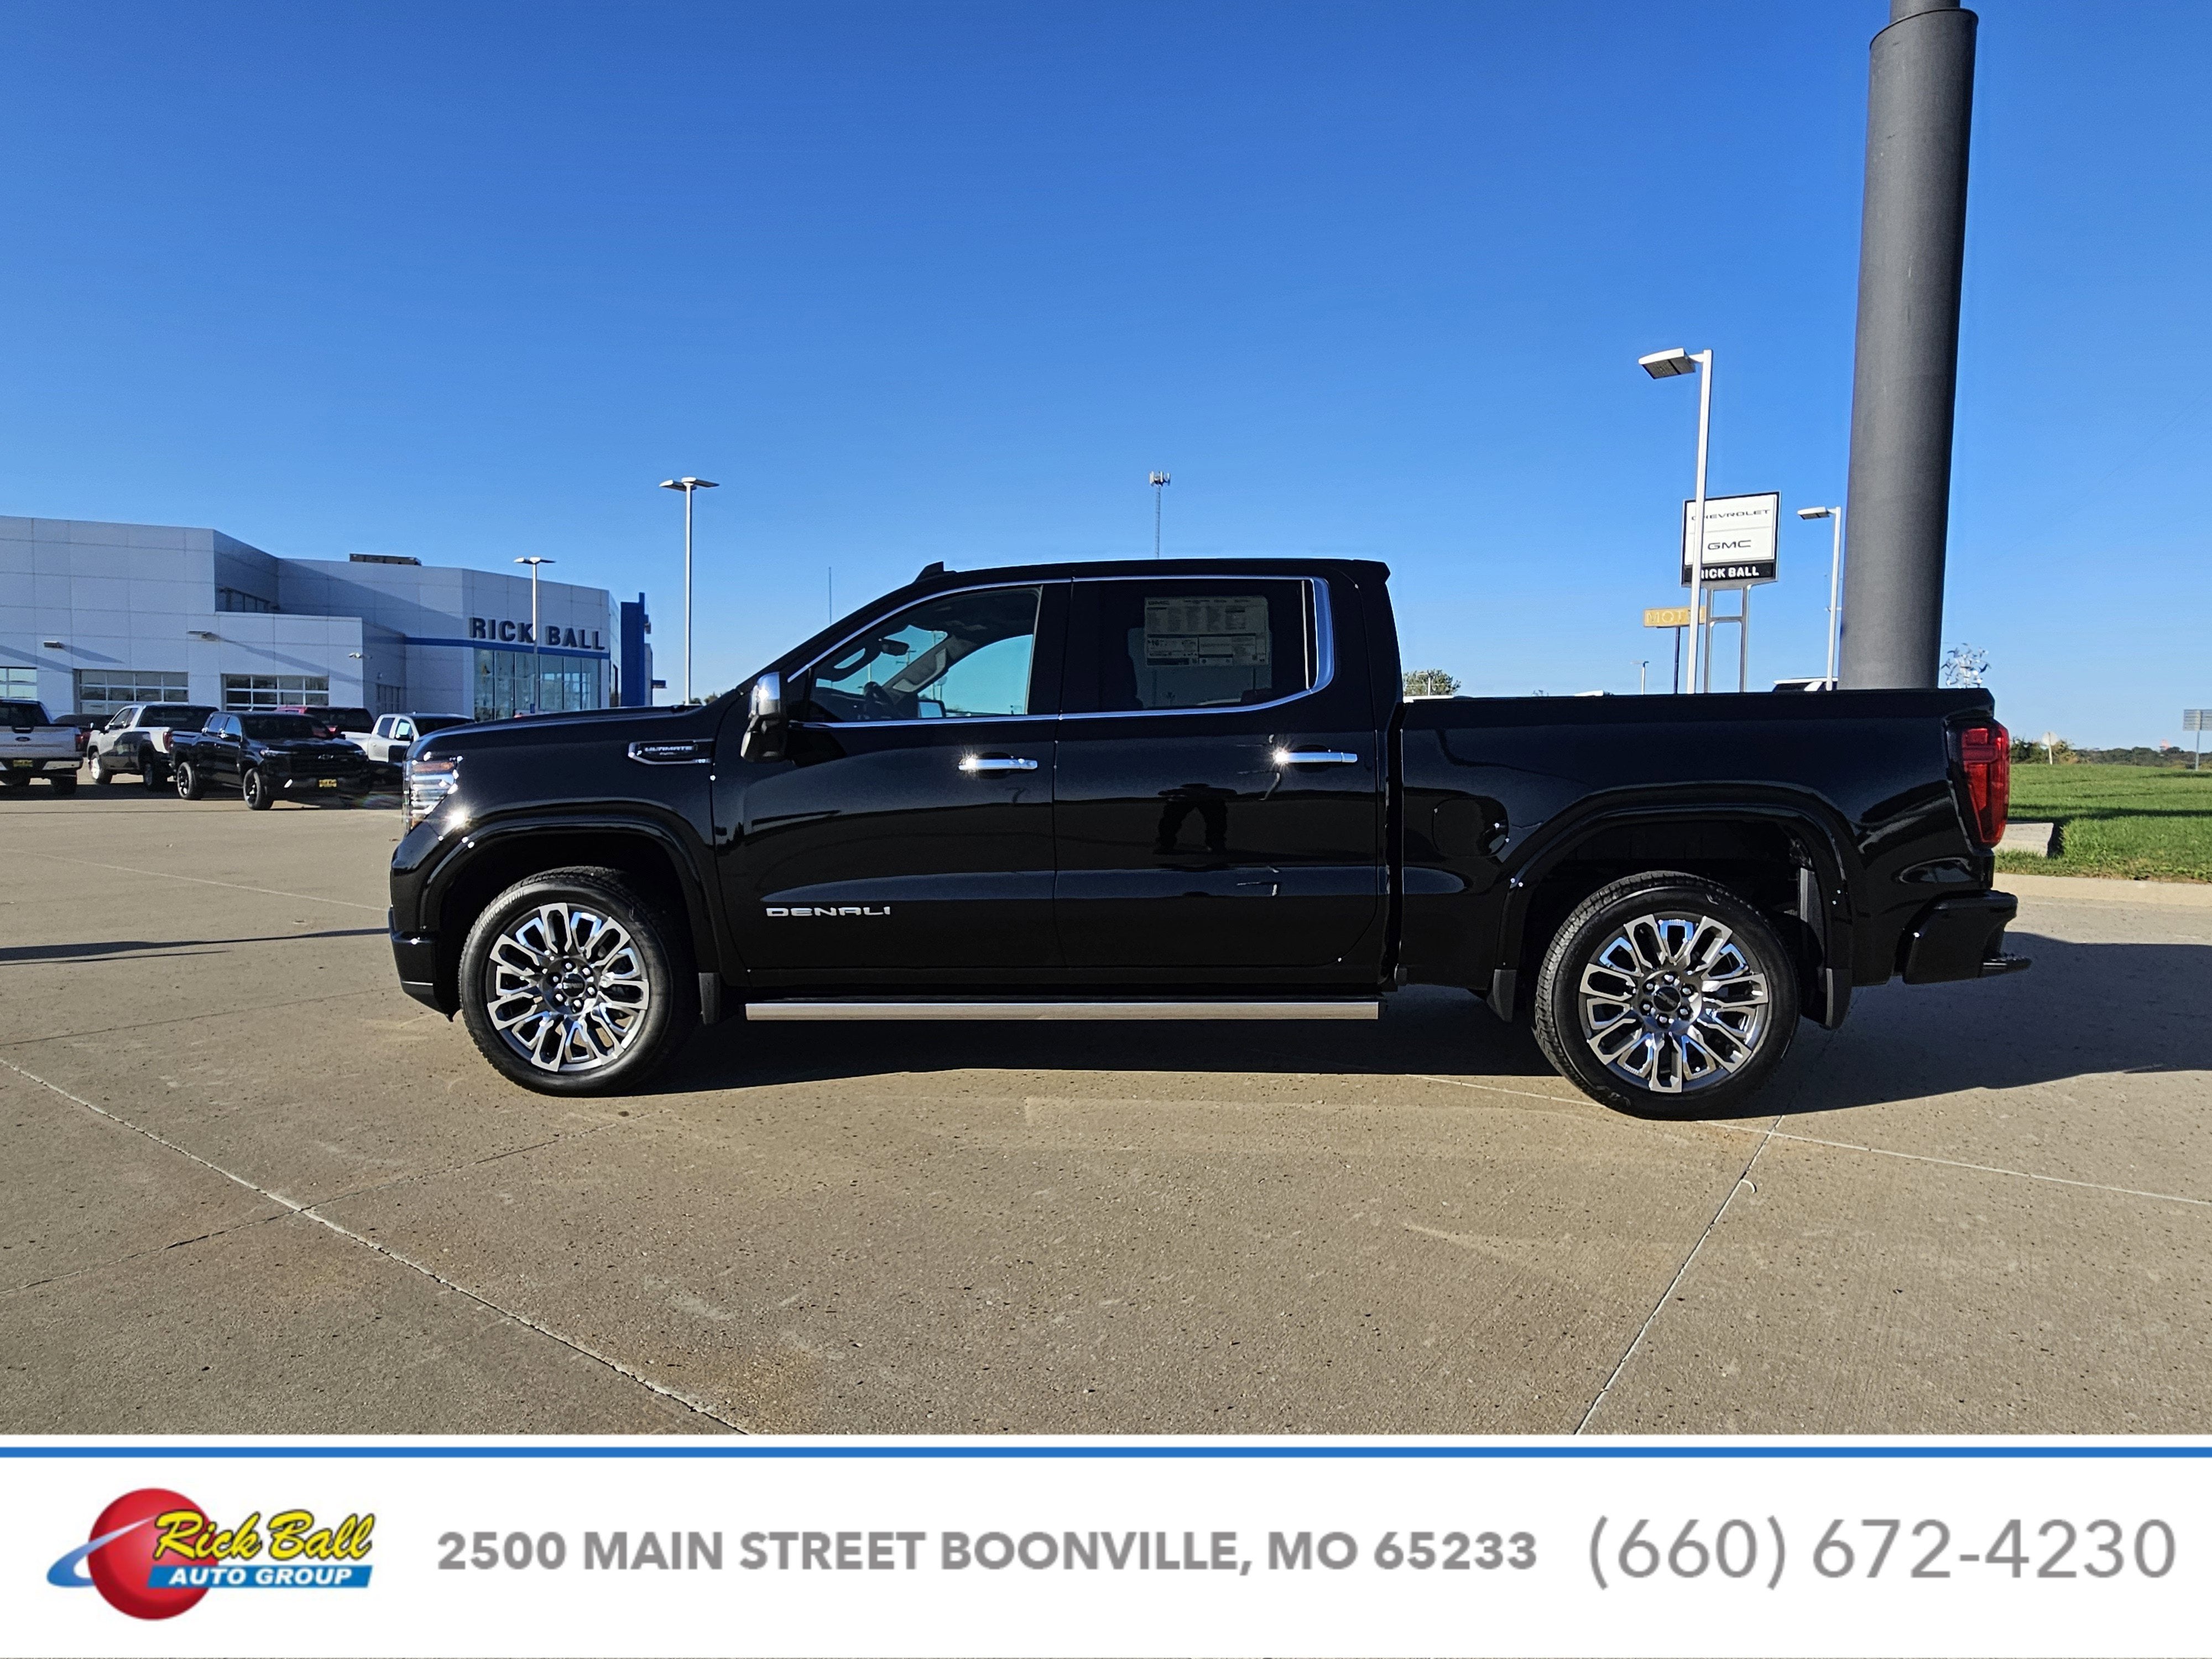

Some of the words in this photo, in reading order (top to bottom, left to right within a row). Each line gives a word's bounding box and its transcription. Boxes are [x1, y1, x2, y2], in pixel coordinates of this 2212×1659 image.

[1707, 540, 1751, 550] GMC
[1728, 566, 1759, 577] BALL
[469, 617, 535, 643] RICK
[545, 625, 606, 650] BALL
[766, 906, 890, 916] DENALI
